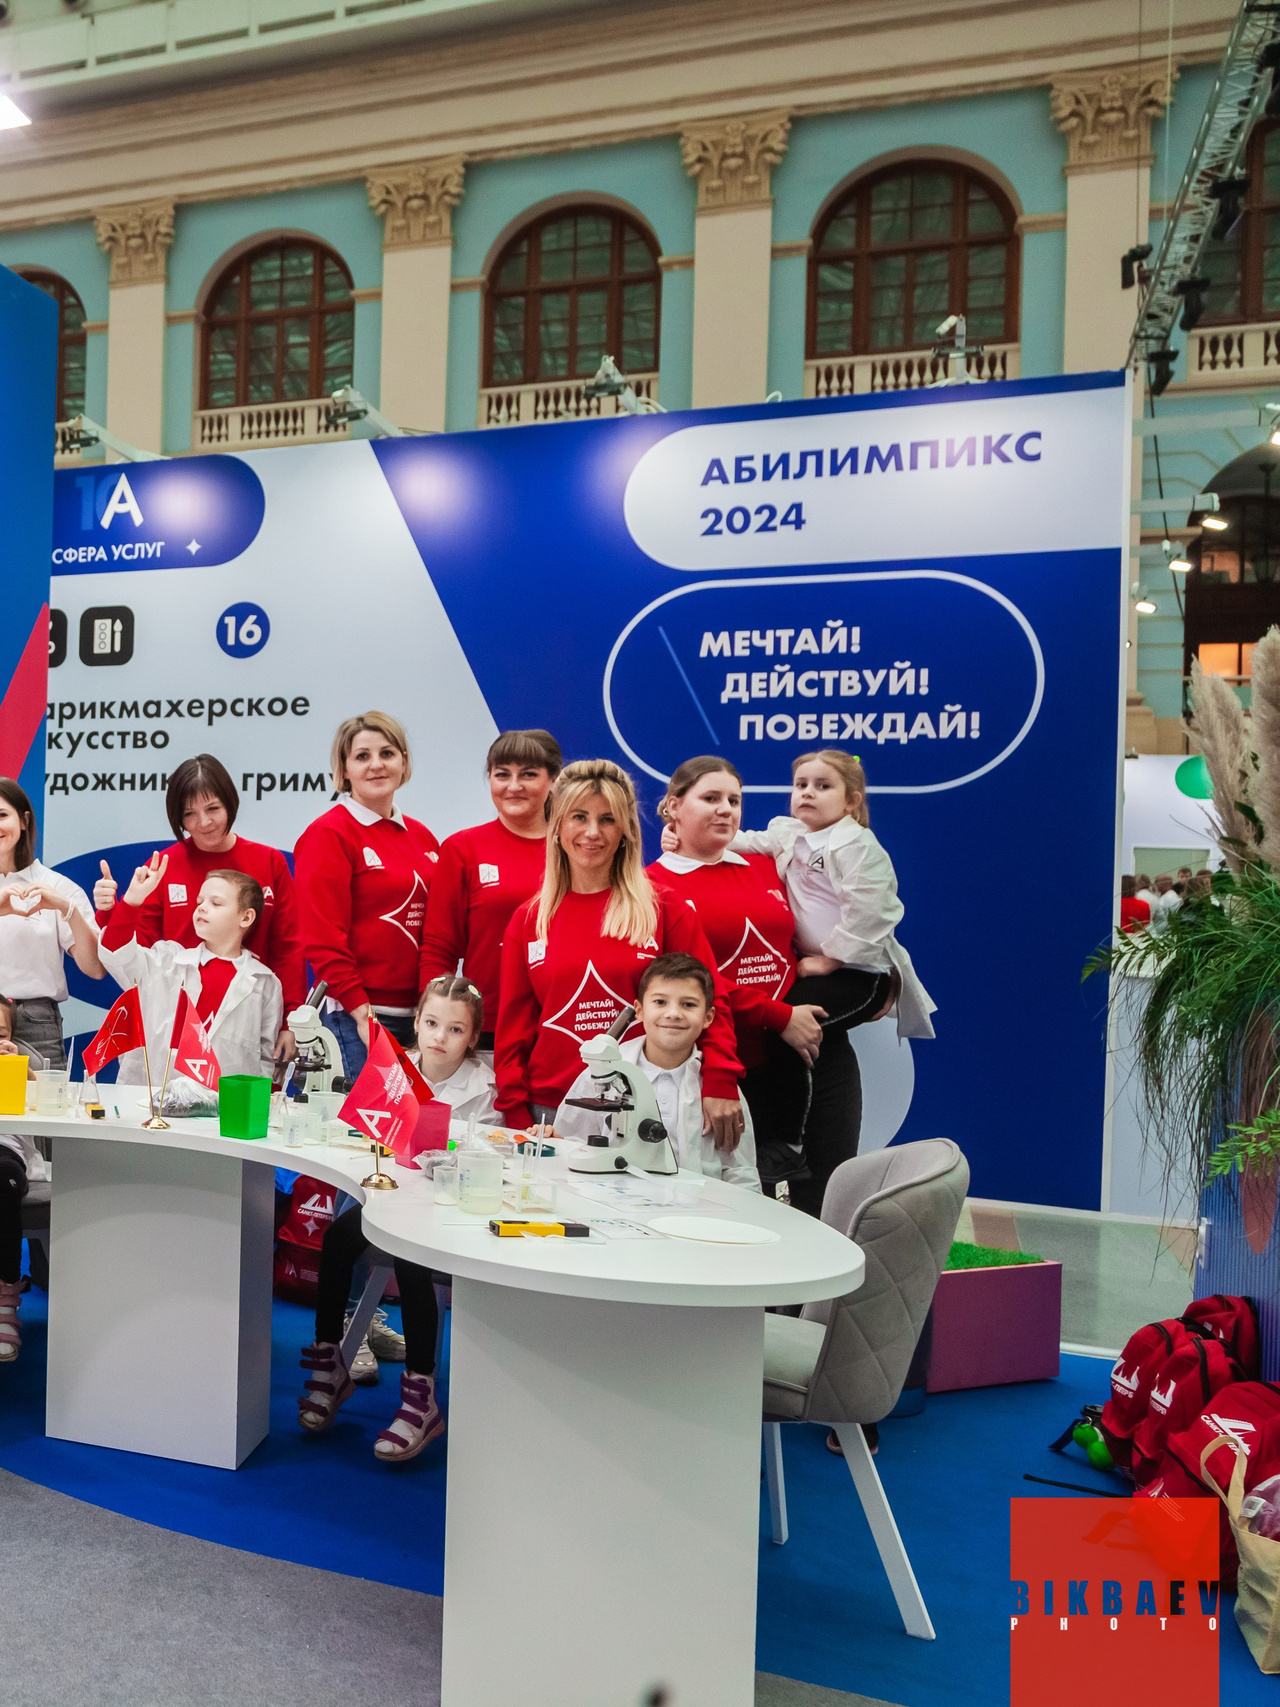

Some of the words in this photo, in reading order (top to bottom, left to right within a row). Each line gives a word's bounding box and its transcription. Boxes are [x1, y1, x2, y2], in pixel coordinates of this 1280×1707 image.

[699, 430, 1042, 487] АБИЛИМПИКС
[699, 501, 806, 537] 2024
[52, 545, 108, 564] СФЕРА
[111, 541, 165, 560] УСЛУГ
[224, 614, 262, 646] 16
[699, 619, 861, 658] МЕЧТАЙ!
[720, 660, 929, 704] ДЕЙСТВУЙ!
[738, 704, 980, 745] ПОБЕЖДАЙ!
[740, 953, 773, 964] МЕЧТАЙ!
[579, 999, 614, 1010] МЕЧТАЙ!
[574, 1022, 613, 1032] ПОБЕЖД
